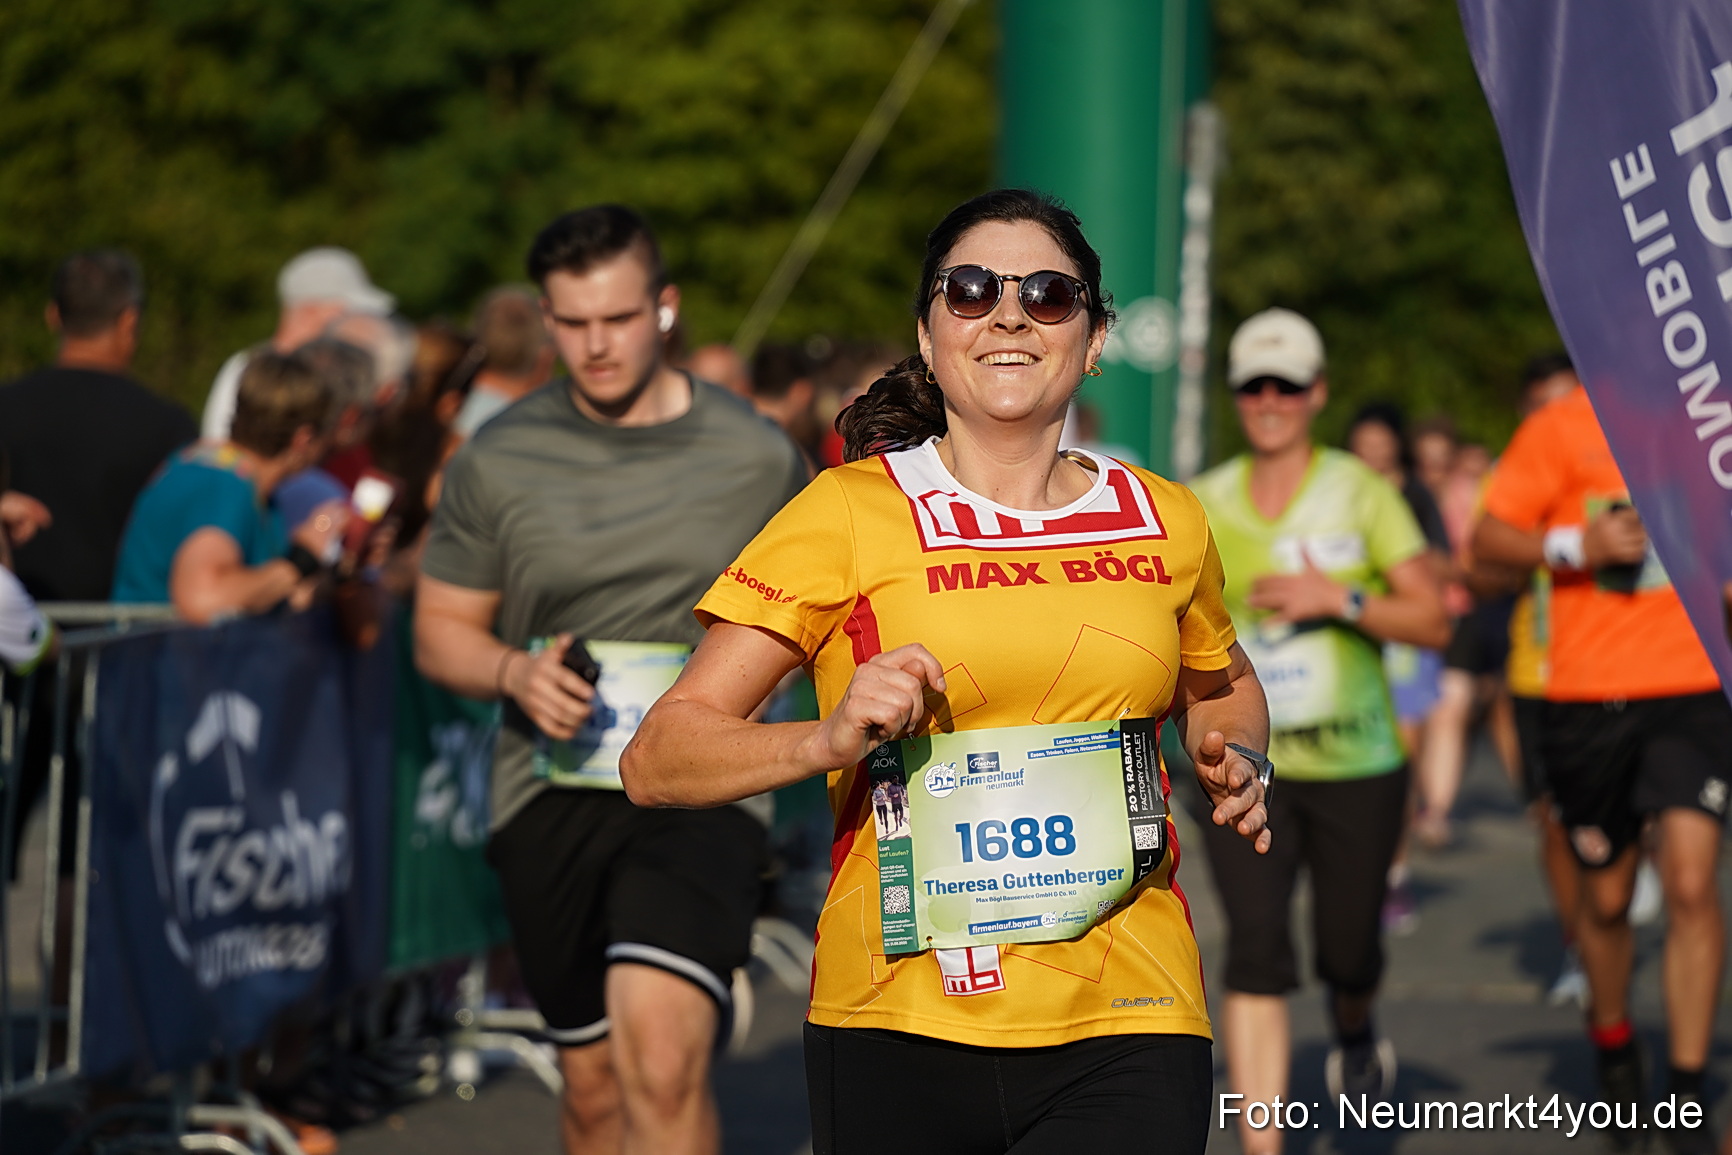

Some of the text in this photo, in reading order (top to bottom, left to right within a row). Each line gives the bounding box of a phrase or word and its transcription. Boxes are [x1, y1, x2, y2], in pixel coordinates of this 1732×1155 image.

[925, 552, 1173, 595] MAX BÖGL
[872, 757, 898, 769] AOK
[1122, 732, 1139, 813] 20 % RABATT
[1133, 733, 1149, 811] FACTORY OUTLET
[960, 768, 1025, 787] Firmenlauf
[985, 779, 1025, 791] neumarkt
[955, 814, 1077, 863] 1688
[924, 868, 1125, 896] Theresa Guttenberger
[1035, 891, 1053, 899] GmbH
[971, 918, 1039, 934] firmenlauf.bayern
